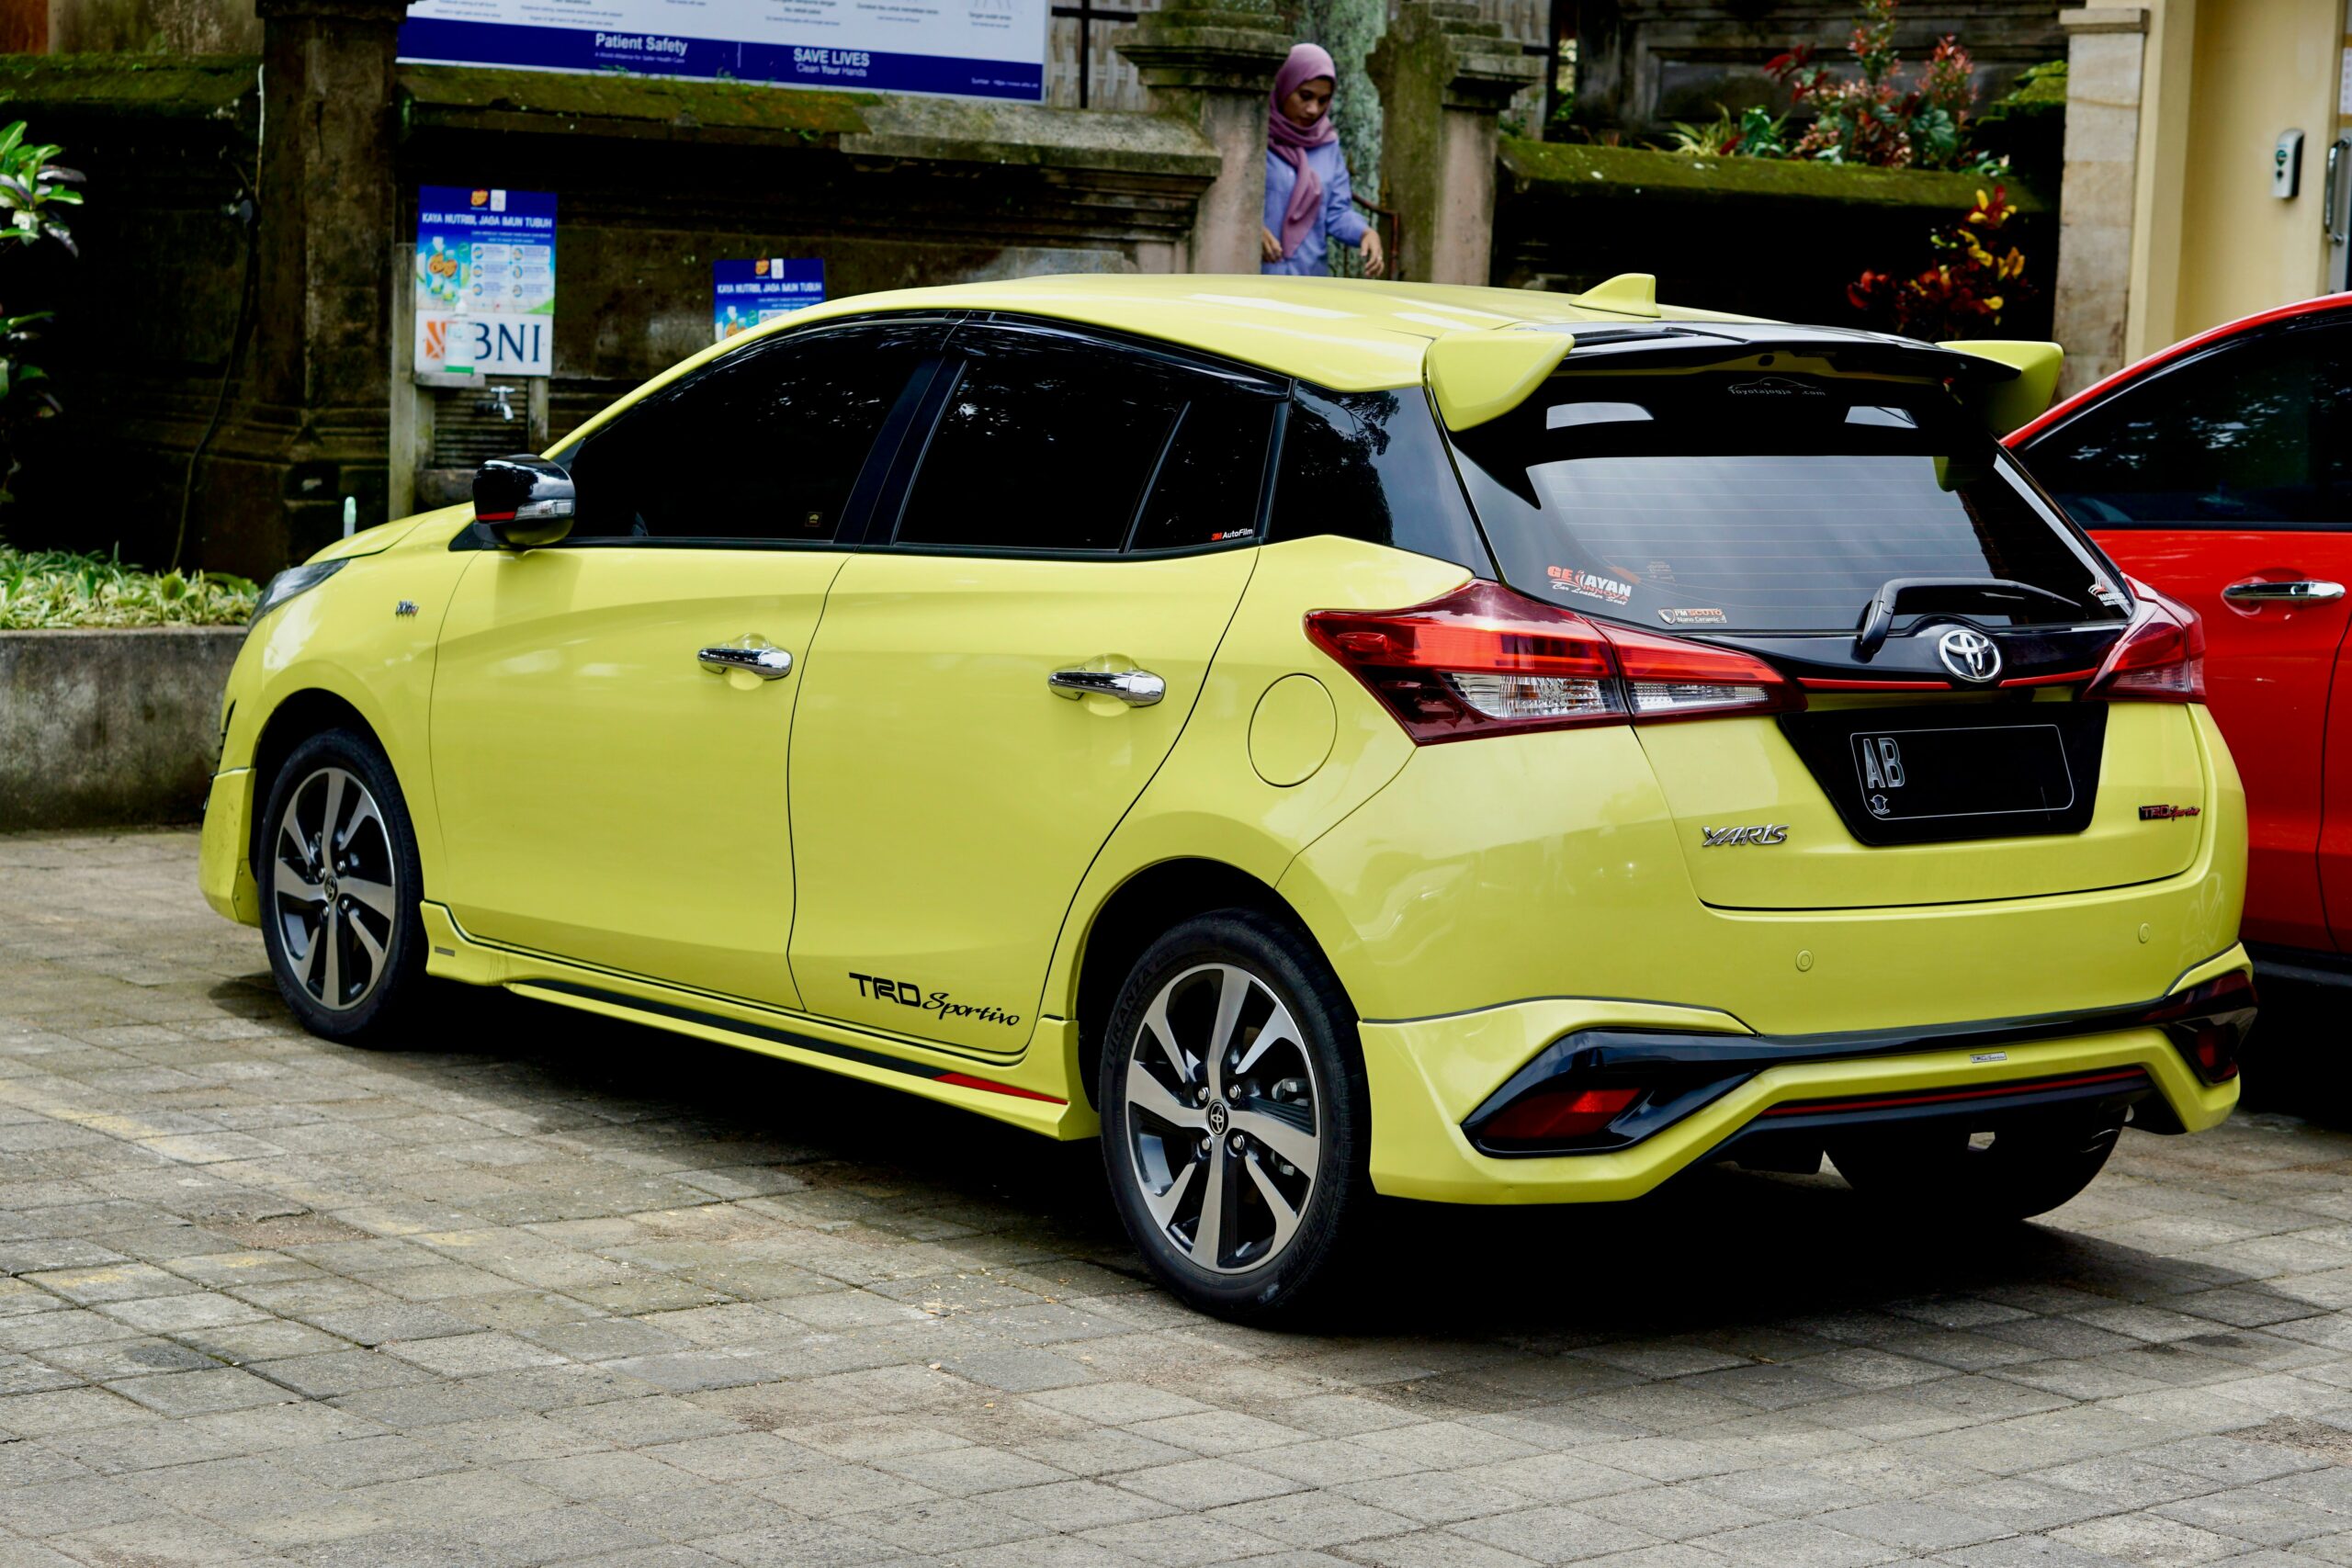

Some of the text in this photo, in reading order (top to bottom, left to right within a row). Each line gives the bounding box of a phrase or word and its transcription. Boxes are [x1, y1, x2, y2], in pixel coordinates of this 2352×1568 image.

[594, 32, 688, 57] Patient Safety
[793, 47, 871, 68] SAVE LIVES
[796, 62, 868, 78] Clean Your Hands
[1222, 528, 1253, 539] AutoFilm
[1583, 584, 1629, 602] INNOVA
[1863, 737, 1905, 789] AB
[2139, 805, 2169, 820] TRD
[1702, 823, 1791, 847] YARIS
[848, 972, 1021, 1026] TRD Sportivo
